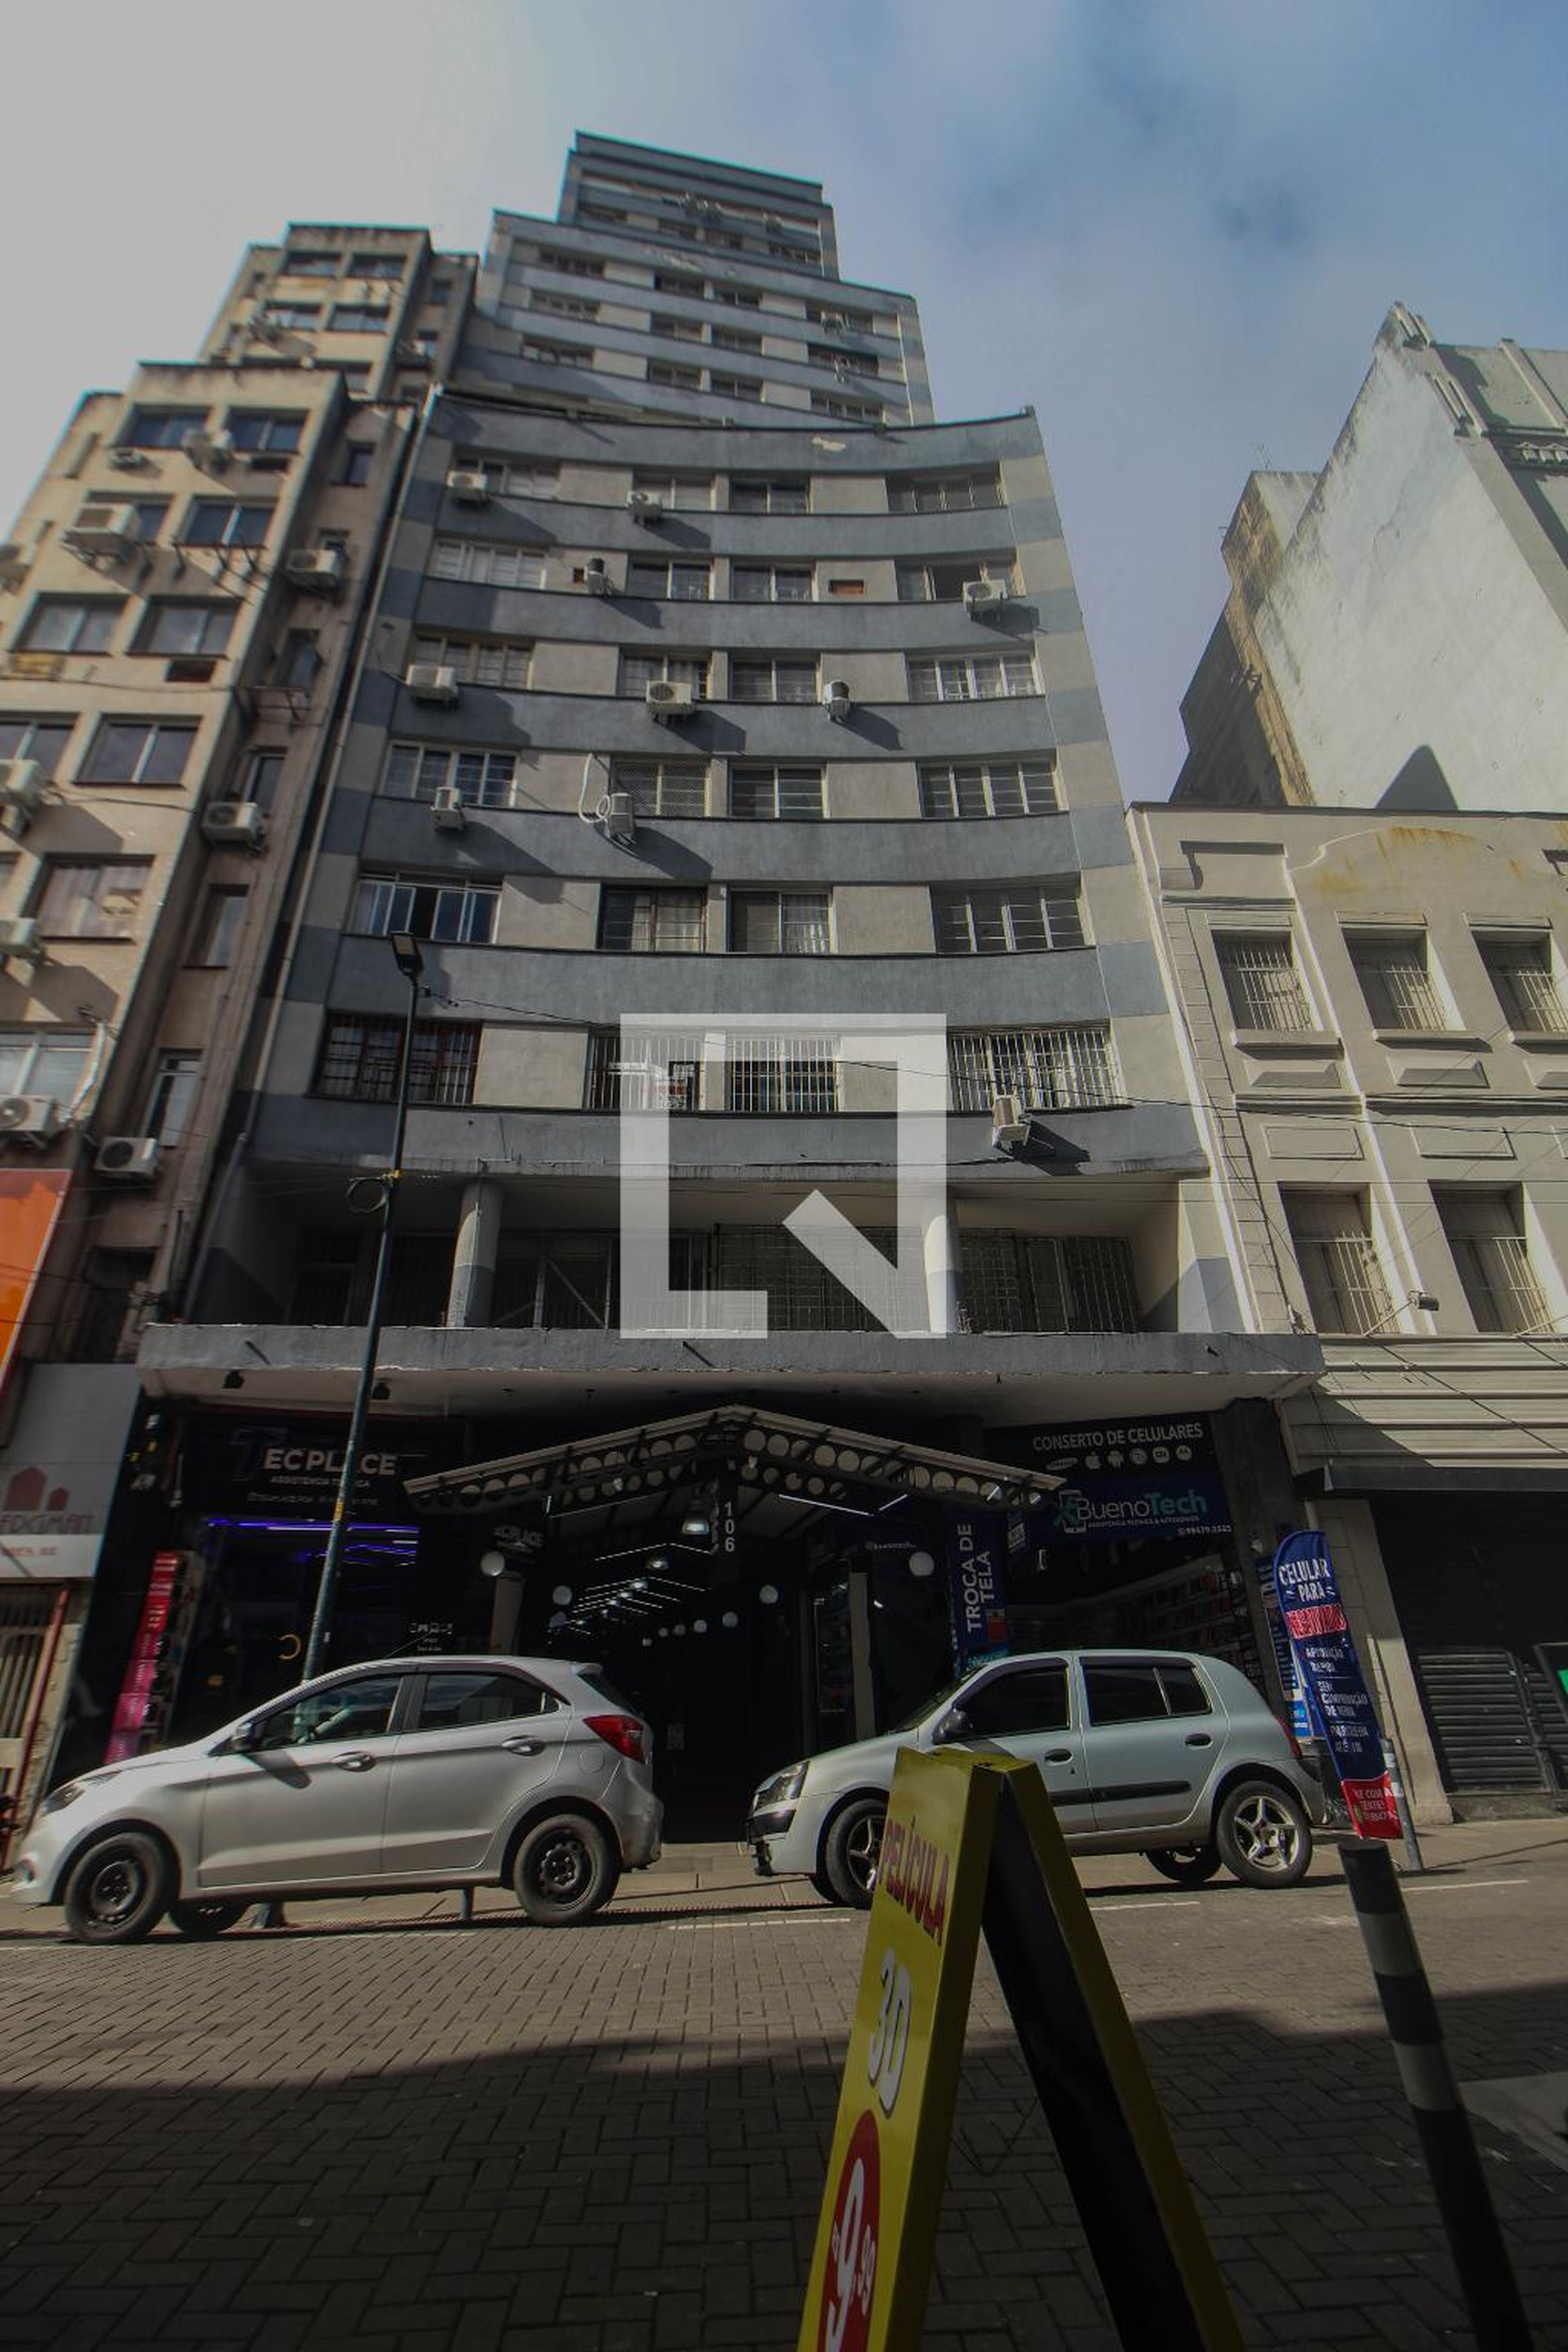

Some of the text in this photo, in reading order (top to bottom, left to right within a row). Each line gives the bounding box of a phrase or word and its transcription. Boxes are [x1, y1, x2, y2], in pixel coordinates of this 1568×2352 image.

[1032, 1422, 1203, 1451] CONSERTO DE CELULARES
[1076, 1488, 1207, 1520] BuenoTech
[724, 1500, 735, 1552] 106
[957, 1523, 982, 1634] TROCA DE
[976, 1550, 996, 1604] TELA
[1278, 1558, 1330, 1586] CELULAR
[1298, 1581, 1325, 1602] PARA
[1324, 1705, 1337, 1716] DE
[879, 1815, 949, 1947] PELÍCULA
[869, 1948, 912, 2119] 3D
